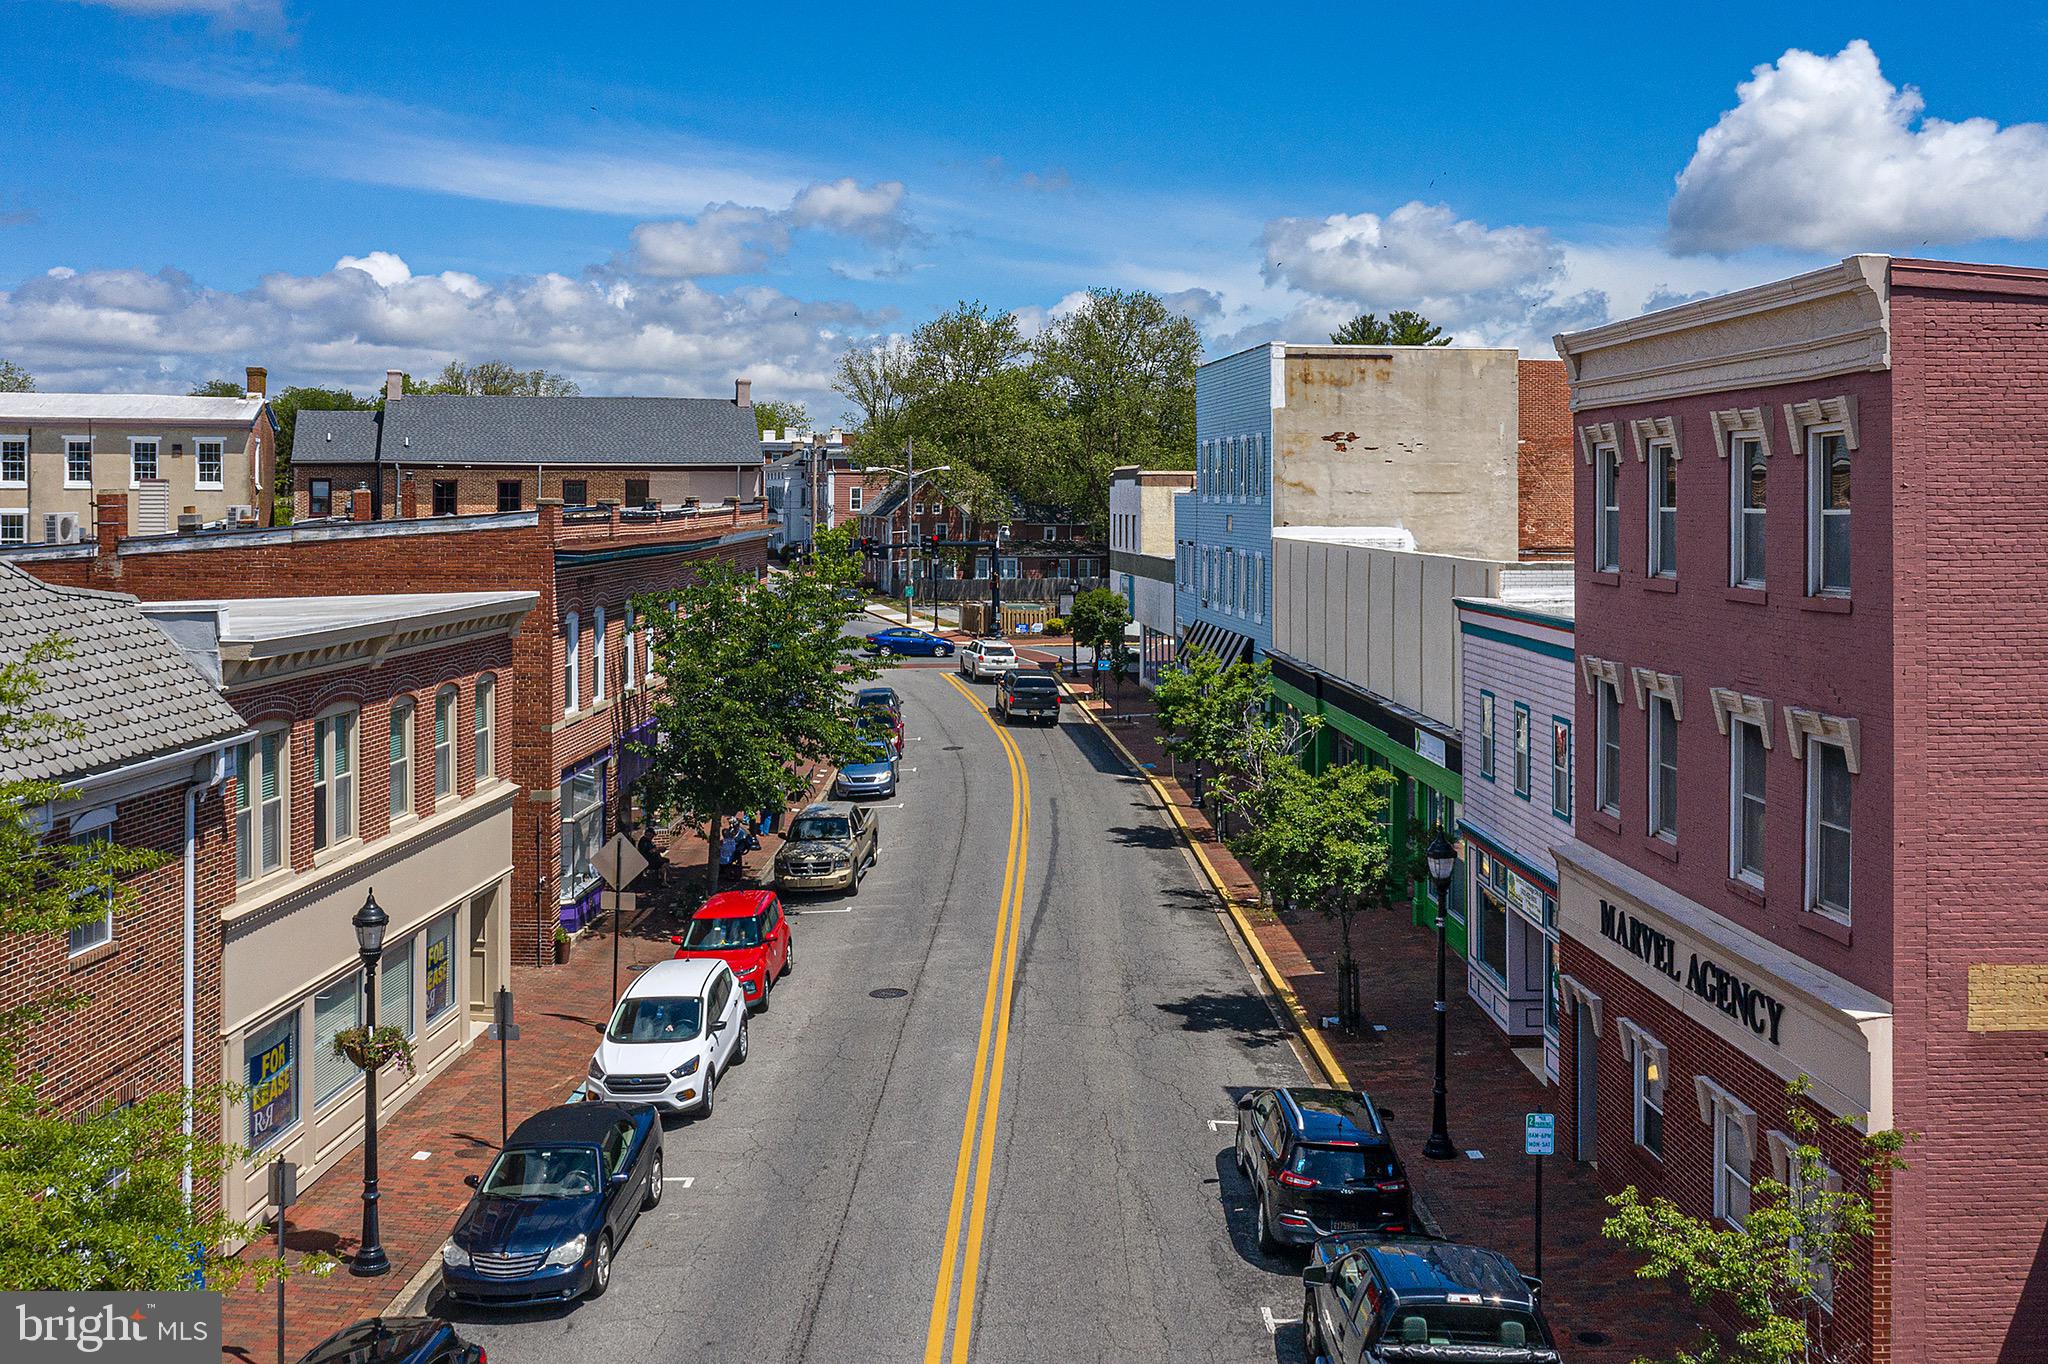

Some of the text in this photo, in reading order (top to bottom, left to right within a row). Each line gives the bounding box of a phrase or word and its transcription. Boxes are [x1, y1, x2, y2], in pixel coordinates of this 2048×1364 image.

[428, 941, 445, 968] FOR
[1600, 899, 1785, 1046] MARVEL AGENCY
[427, 960, 448, 991] EASE
[261, 1042, 286, 1080] FOR
[253, 1066, 290, 1112] LEASE
